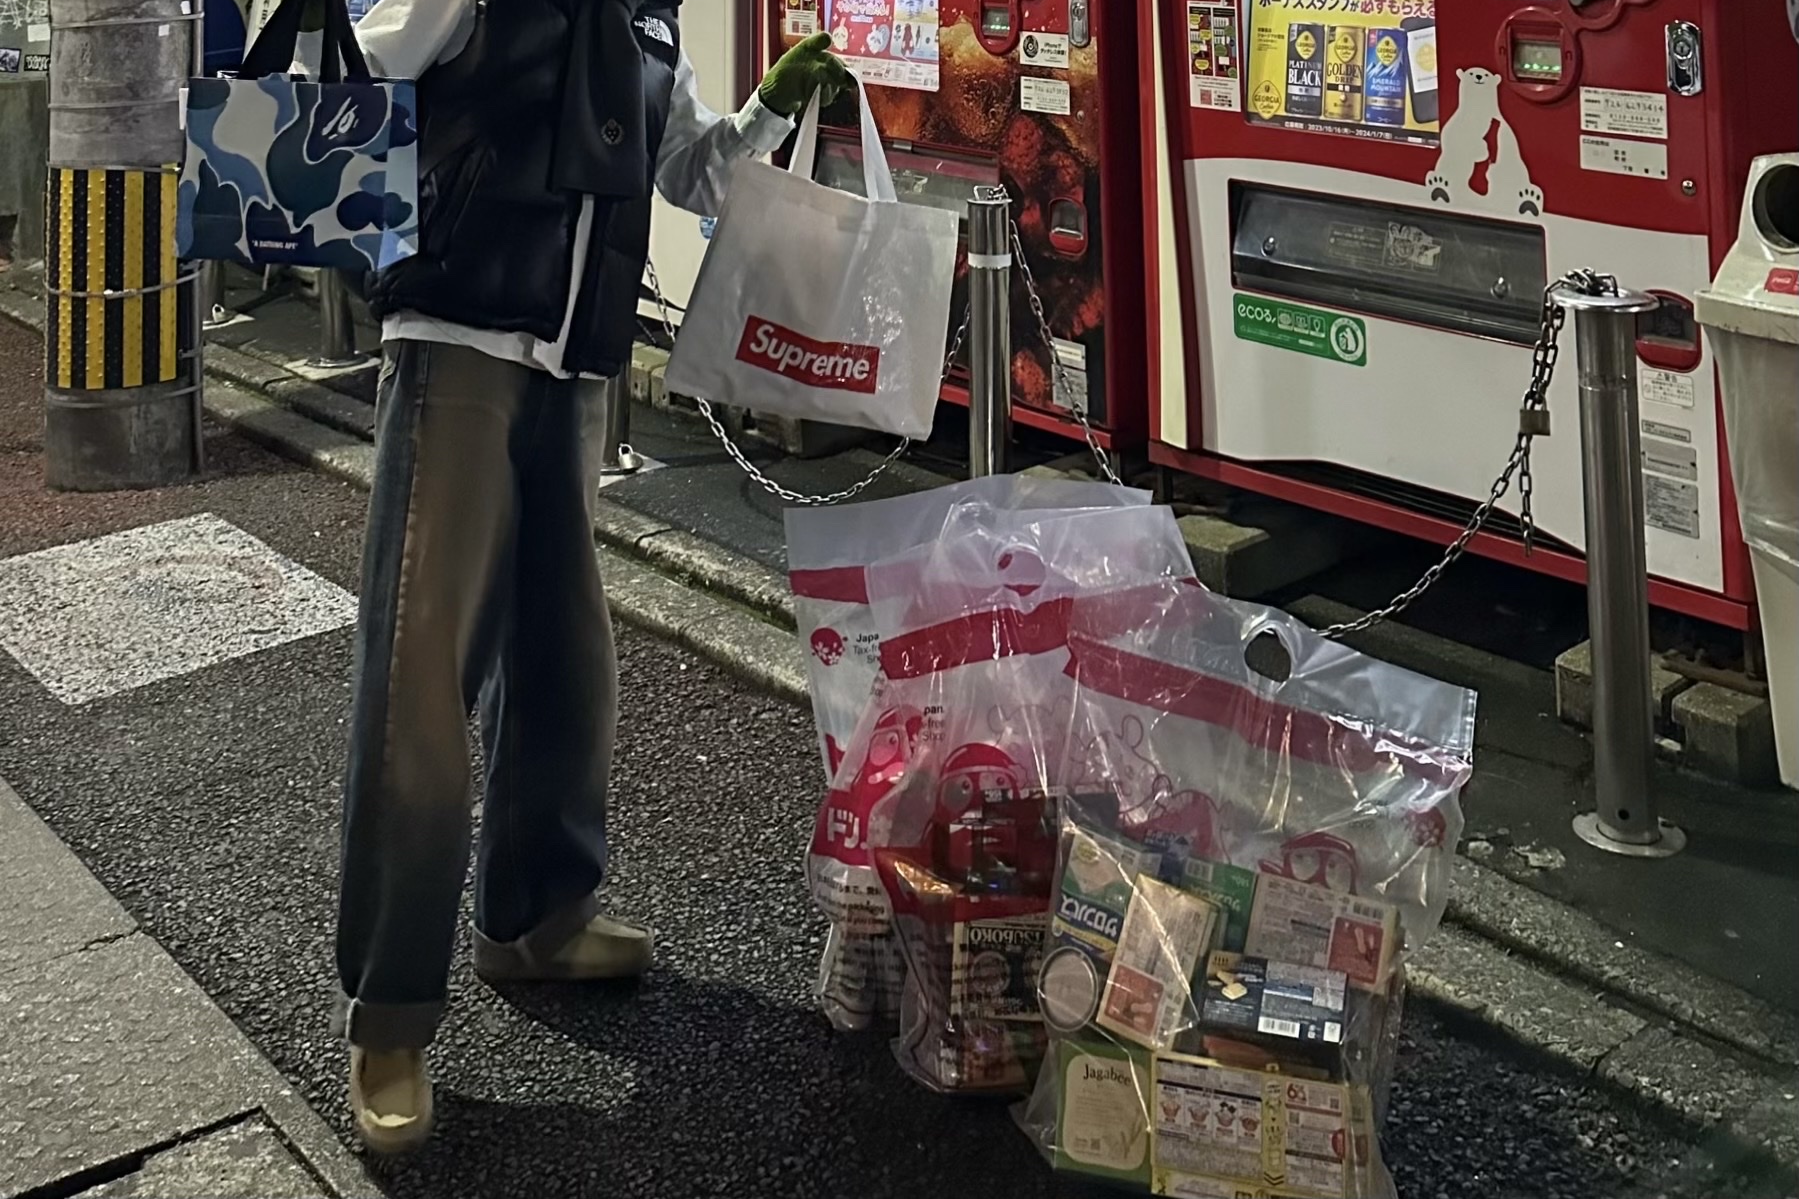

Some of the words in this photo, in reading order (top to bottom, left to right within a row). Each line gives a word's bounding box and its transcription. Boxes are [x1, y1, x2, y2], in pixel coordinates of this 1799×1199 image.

[1288, 69, 1322, 87] BLACK
[1327, 63, 1363, 79] GOLDEN
[750, 324, 870, 380] Supreme
[856, 633, 879, 643] Japa
[854, 645, 879, 656] Tax-fr
[924, 705, 944, 716] pan
[1061, 895, 1118, 938] サロンパス
[1083, 1063, 1132, 1087] Jagabee
